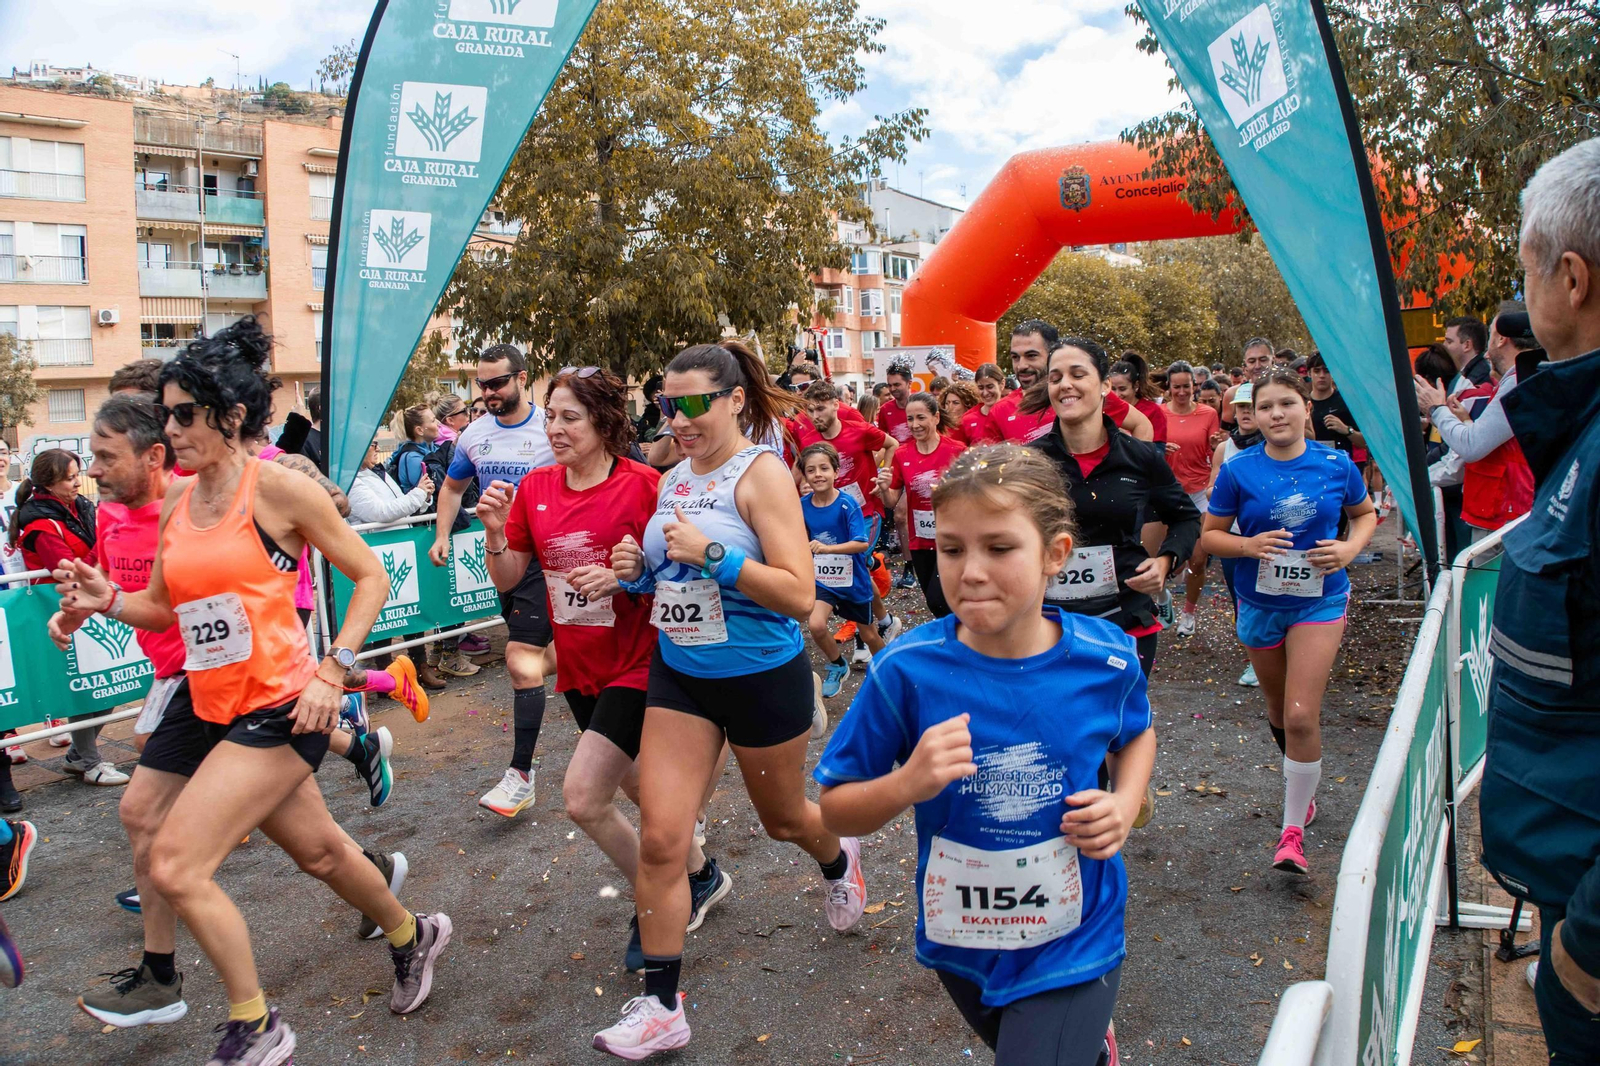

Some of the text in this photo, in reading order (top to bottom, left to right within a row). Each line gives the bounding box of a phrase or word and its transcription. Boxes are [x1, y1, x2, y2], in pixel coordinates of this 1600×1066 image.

[433, 23, 552, 47] CAJA RURAL
[455, 42, 525, 58] GRANADA
[384, 83, 401, 156] fundación
[384, 159, 479, 178] CAJA RURAL
[401, 174, 457, 188] GRANADA
[1115, 181, 1185, 199] Concejalía
[359, 211, 370, 267] fundación
[359, 269, 427, 283] CAJA RURAL
[369, 280, 411, 290] GRANADA
[478, 465, 537, 476] MARACEN
[817, 565, 845, 575] 1037
[1057, 568, 1096, 585] 926
[1274, 565, 1311, 580] 1155
[450, 594, 474, 607] CAJA
[463, 600, 496, 613] GRANADA
[384, 604, 421, 621] RURAL
[660, 603, 704, 623] 202
[191, 619, 230, 645] 229
[372, 619, 409, 633] GRANADA
[664, 626, 700, 634] CRISTINA
[69, 661, 156, 692] CAJA RURAL
[92, 679, 142, 700] GRANADA
[962, 782, 1064, 796] HUMANIDAD
[955, 884, 1050, 910] 1154
[961, 915, 1048, 926] EKATERINA
